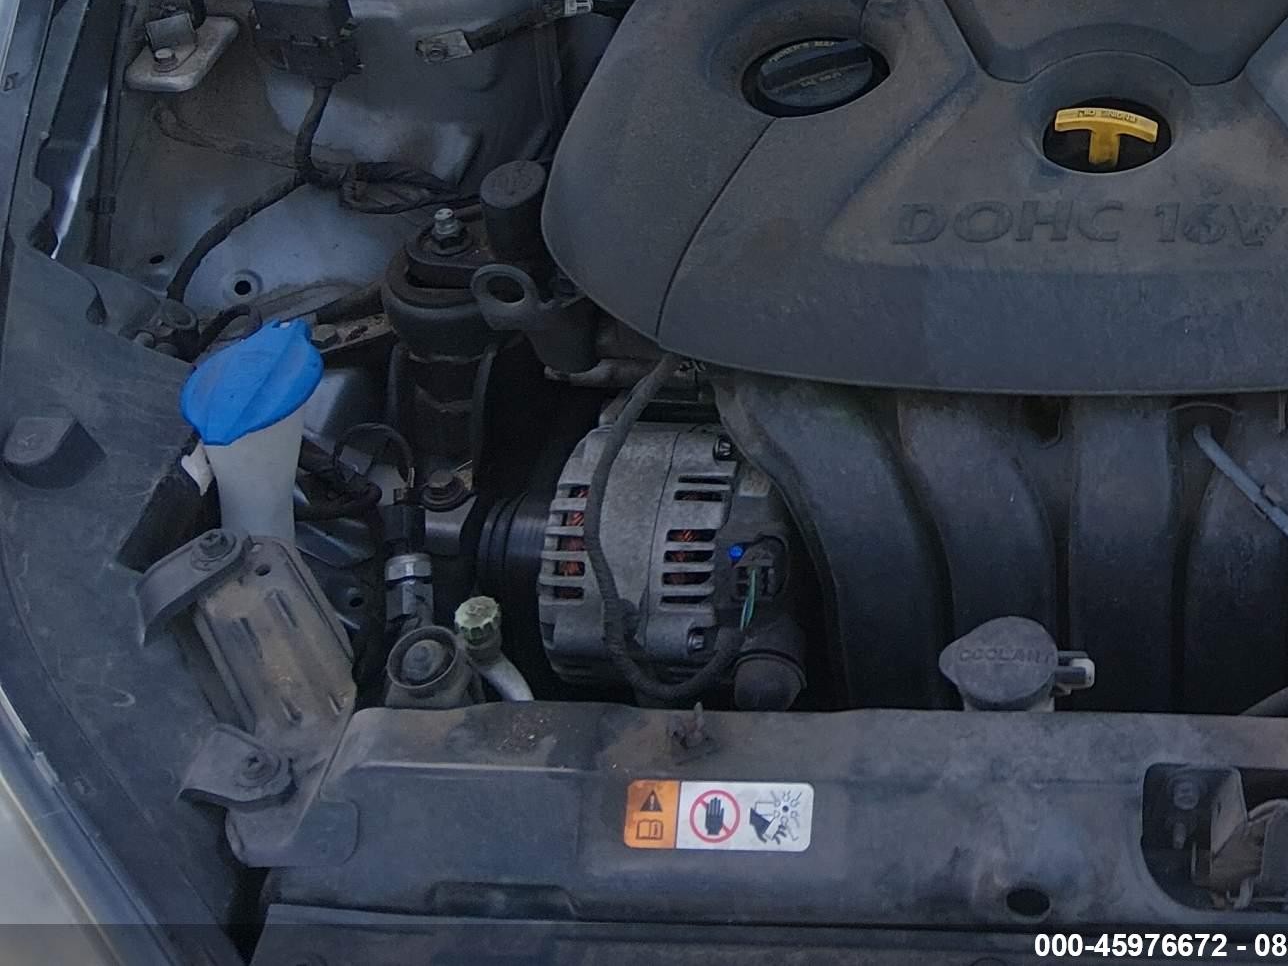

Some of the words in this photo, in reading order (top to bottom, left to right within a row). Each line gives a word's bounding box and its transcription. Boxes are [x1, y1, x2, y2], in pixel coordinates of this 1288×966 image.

[893, 200, 1123, 244] DOHC
[1154, 201, 1288, 246] 16V
[959, 647, 1055, 664] COOLANT
